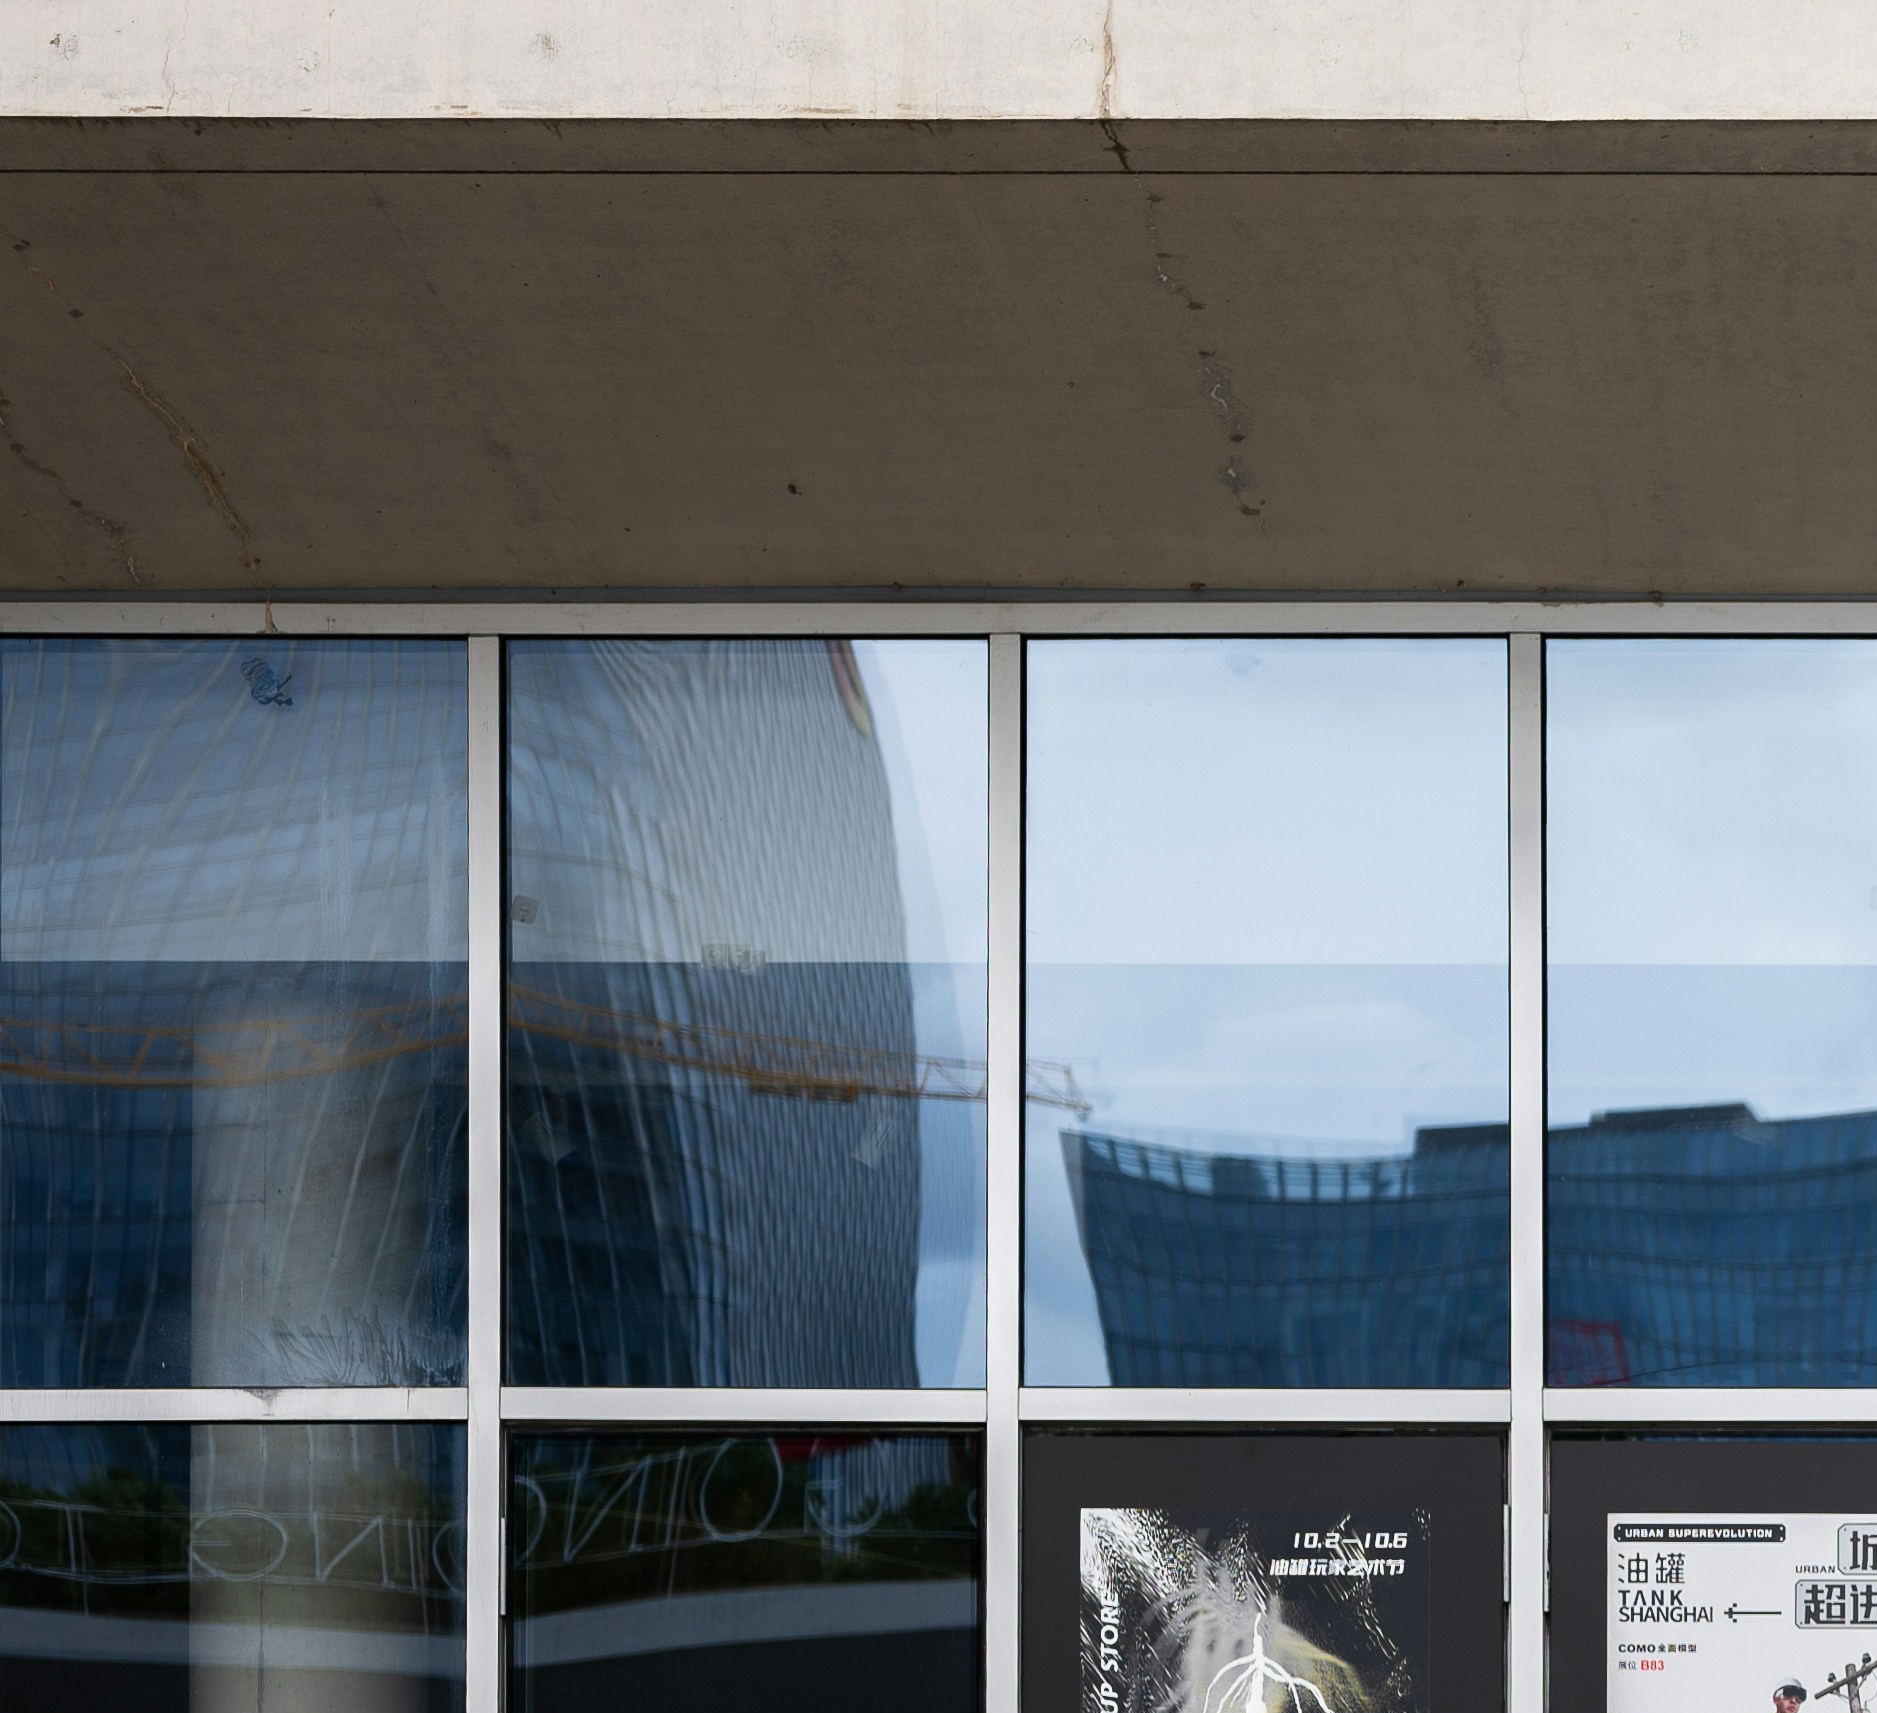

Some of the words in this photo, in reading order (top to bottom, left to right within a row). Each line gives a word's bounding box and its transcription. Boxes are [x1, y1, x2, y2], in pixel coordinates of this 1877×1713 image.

[1625, 1528, 1663, 1538] URBAN
[1669, 1528, 1772, 1538] SUPEREVOLUTION
[1270, 1559, 1405, 1576] 油罐玩家艺术节
[1618, 1552, 1685, 1584] 油罐
[1795, 1565, 1835, 1573] URBAN
[1618, 1590, 1683, 1605] TANK
[1618, 1606, 1713, 1622] SHANGHAI
[1099, 1593, 1118, 1673] STORE
[1618, 1644, 1656, 1653] COMO
[1618, 1661, 1636, 1670] 展位
[1641, 1660, 1664, 1670] B83
